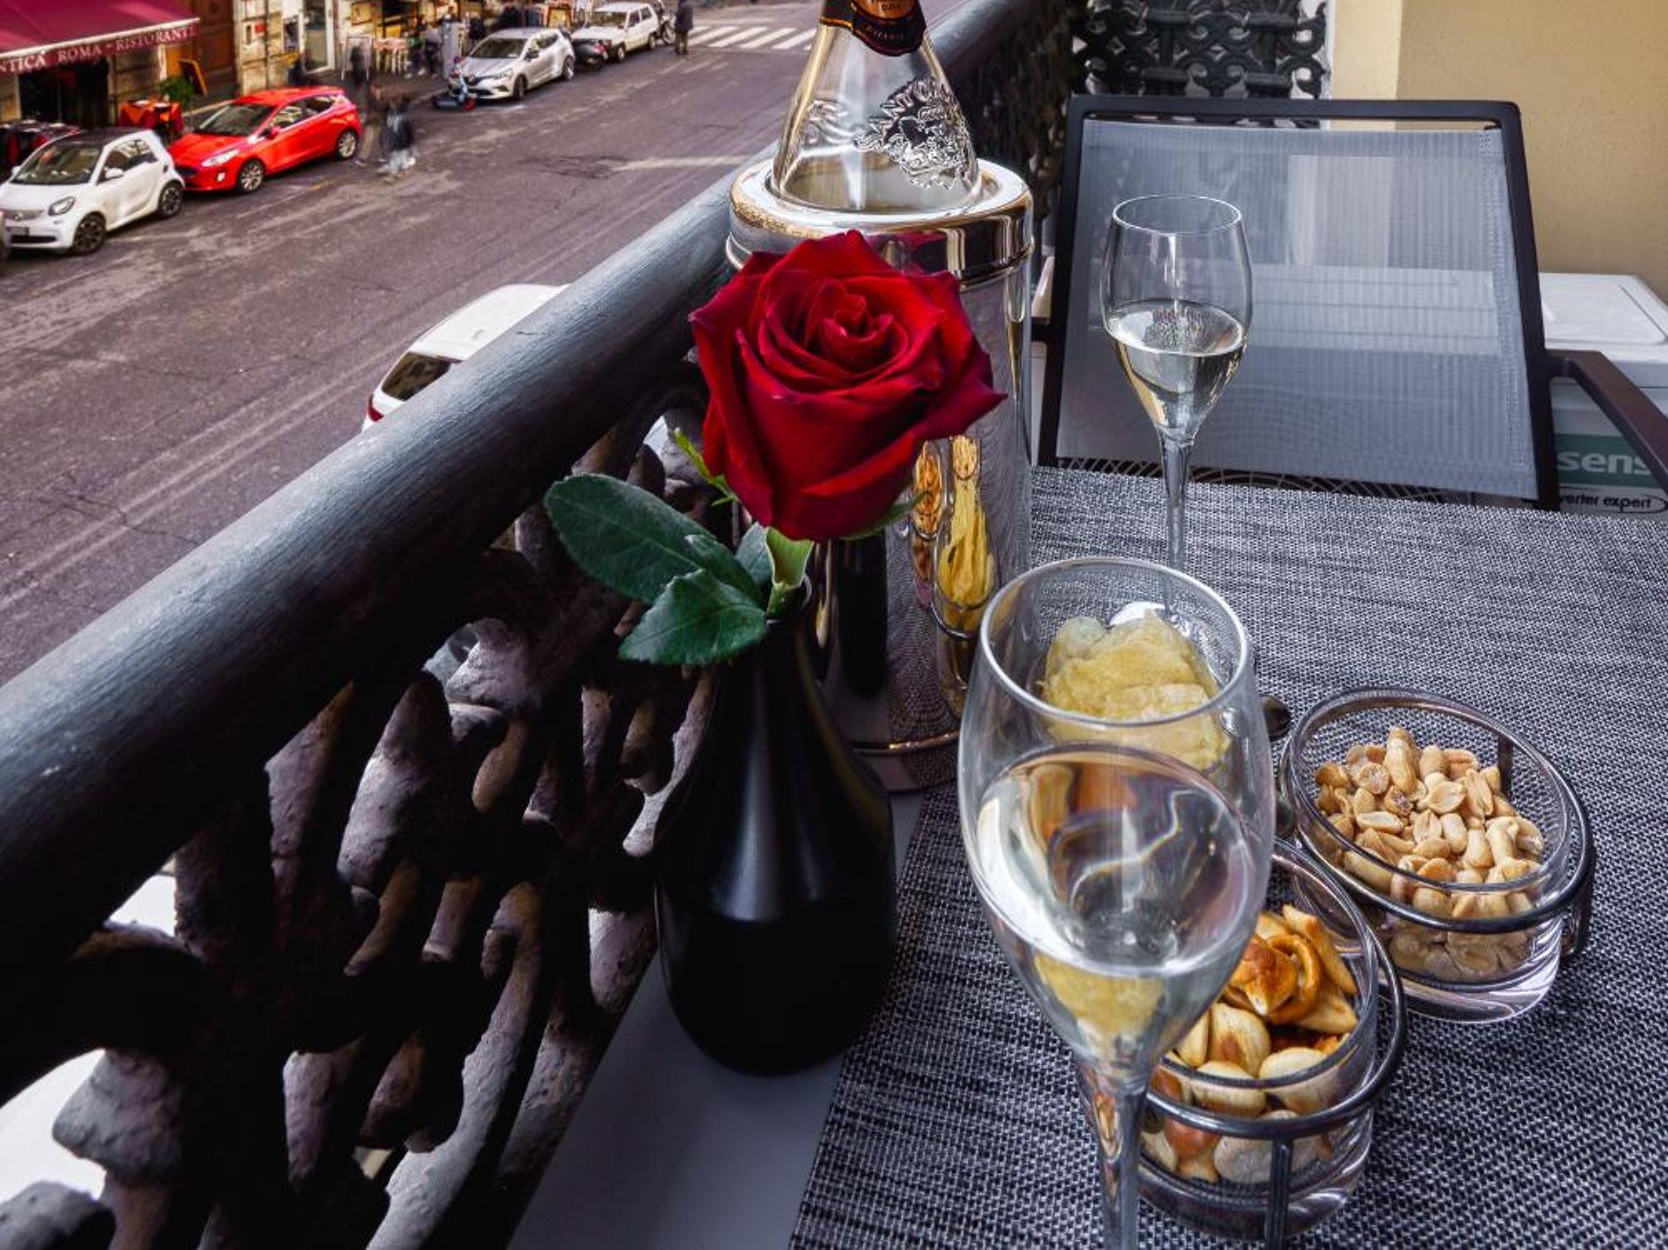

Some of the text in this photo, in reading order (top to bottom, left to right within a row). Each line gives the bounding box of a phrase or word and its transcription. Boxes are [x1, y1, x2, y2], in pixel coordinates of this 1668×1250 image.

[0, 54, 46, 72] NTICA
[58, 44, 102, 63] ROMA
[1558, 452, 1651, 475] sens
